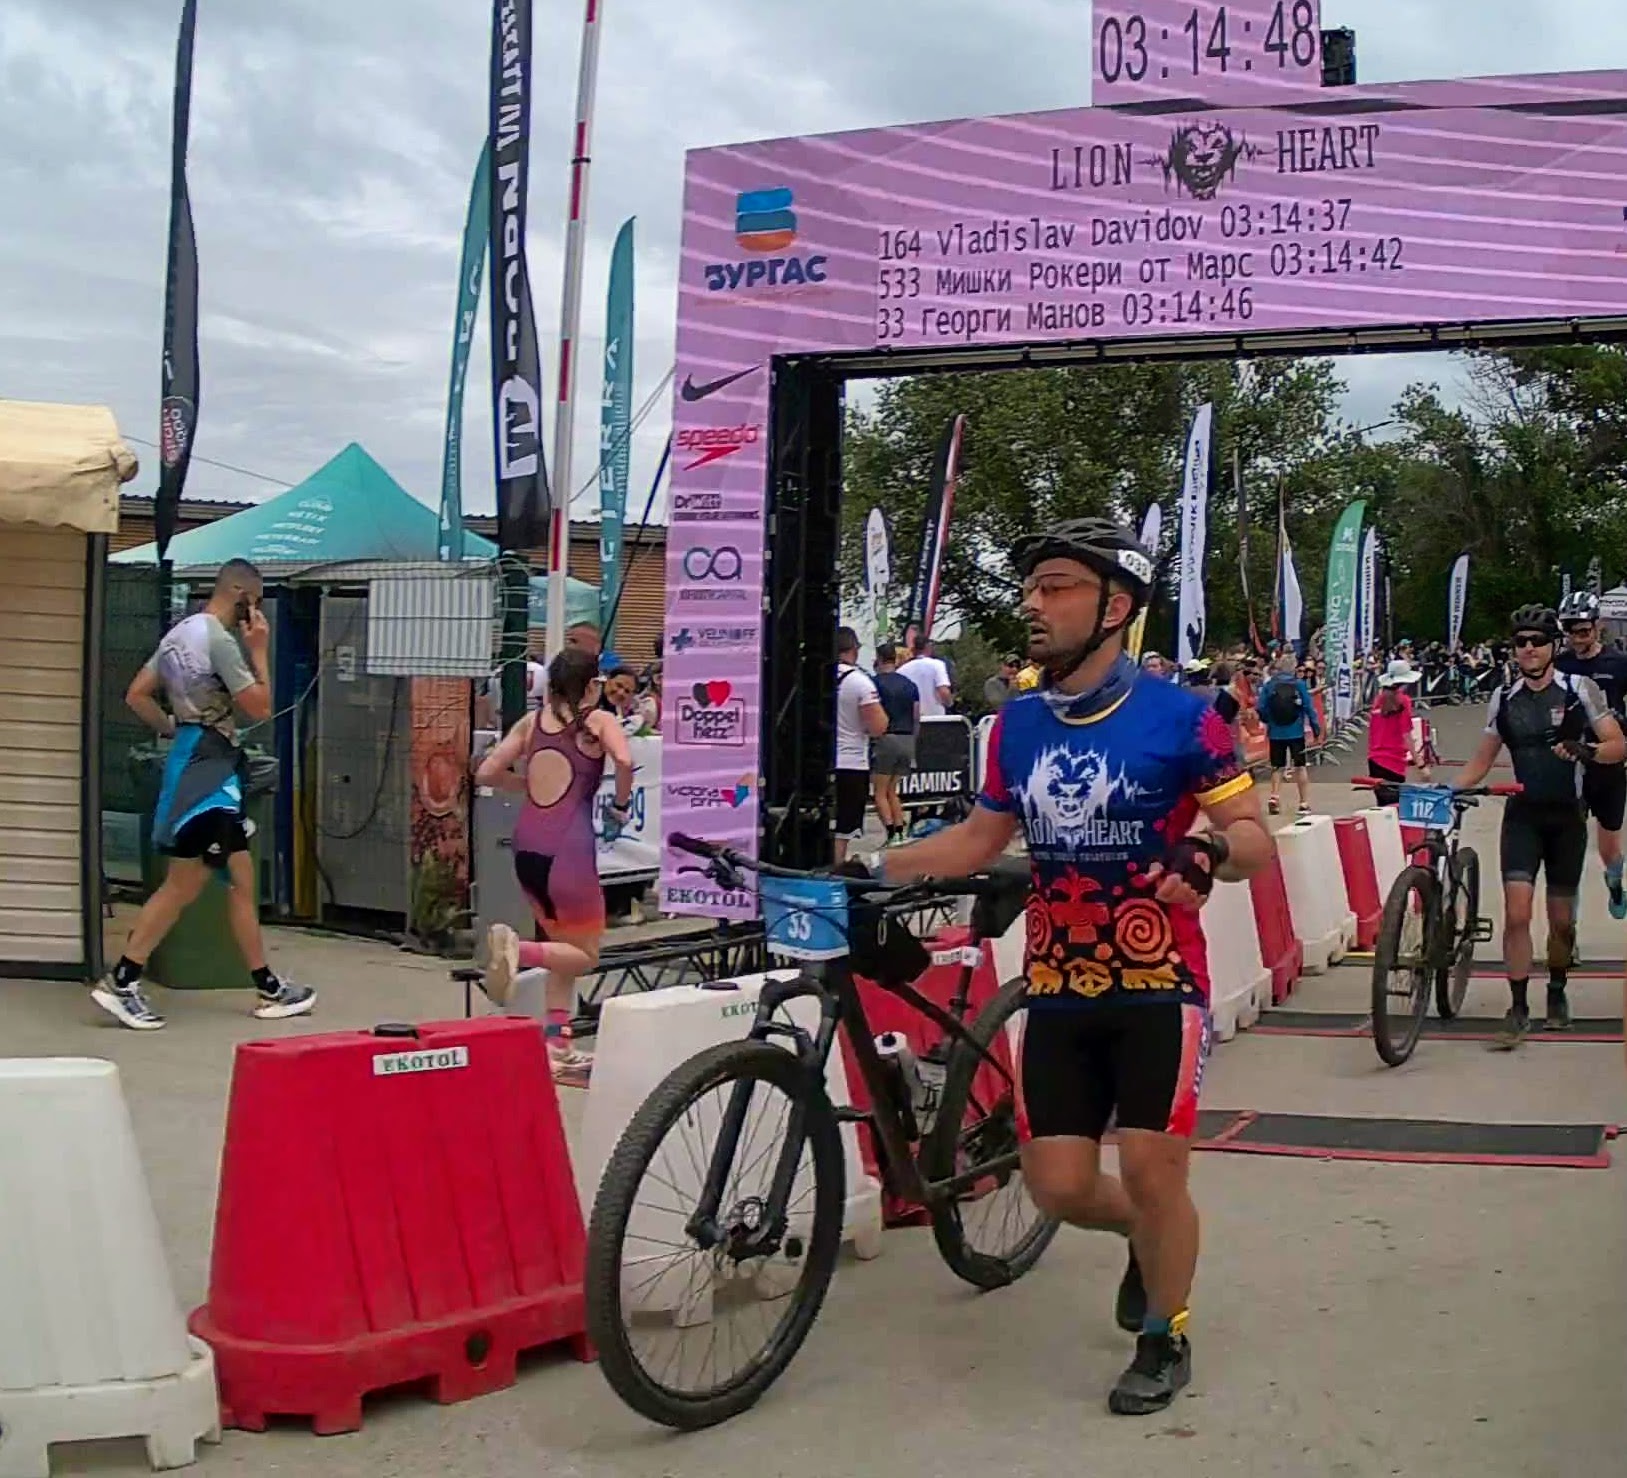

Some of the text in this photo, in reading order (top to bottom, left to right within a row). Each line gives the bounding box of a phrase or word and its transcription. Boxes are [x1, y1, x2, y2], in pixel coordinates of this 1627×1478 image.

[1100, 0, 1316, 83] 03:14:48
[1050, 124, 1381, 191] LION HEART
[878, 198, 1352, 260] 164 Vladislav Davidov 03:14:37
[878, 237, 1404, 299] 533 Мишки Рокери от Марс 03:14:42
[877, 287, 1253, 341] 33 Георги Манов 03:14:46
[676, 423, 760, 450] speedo
[681, 705, 740, 726] Doppel
[693, 724, 730, 740] herz
[1083, 819, 1144, 846] HEART
[666, 887, 751, 909] EKOTOL
[382, 1048, 461, 1072] EKOTOL
